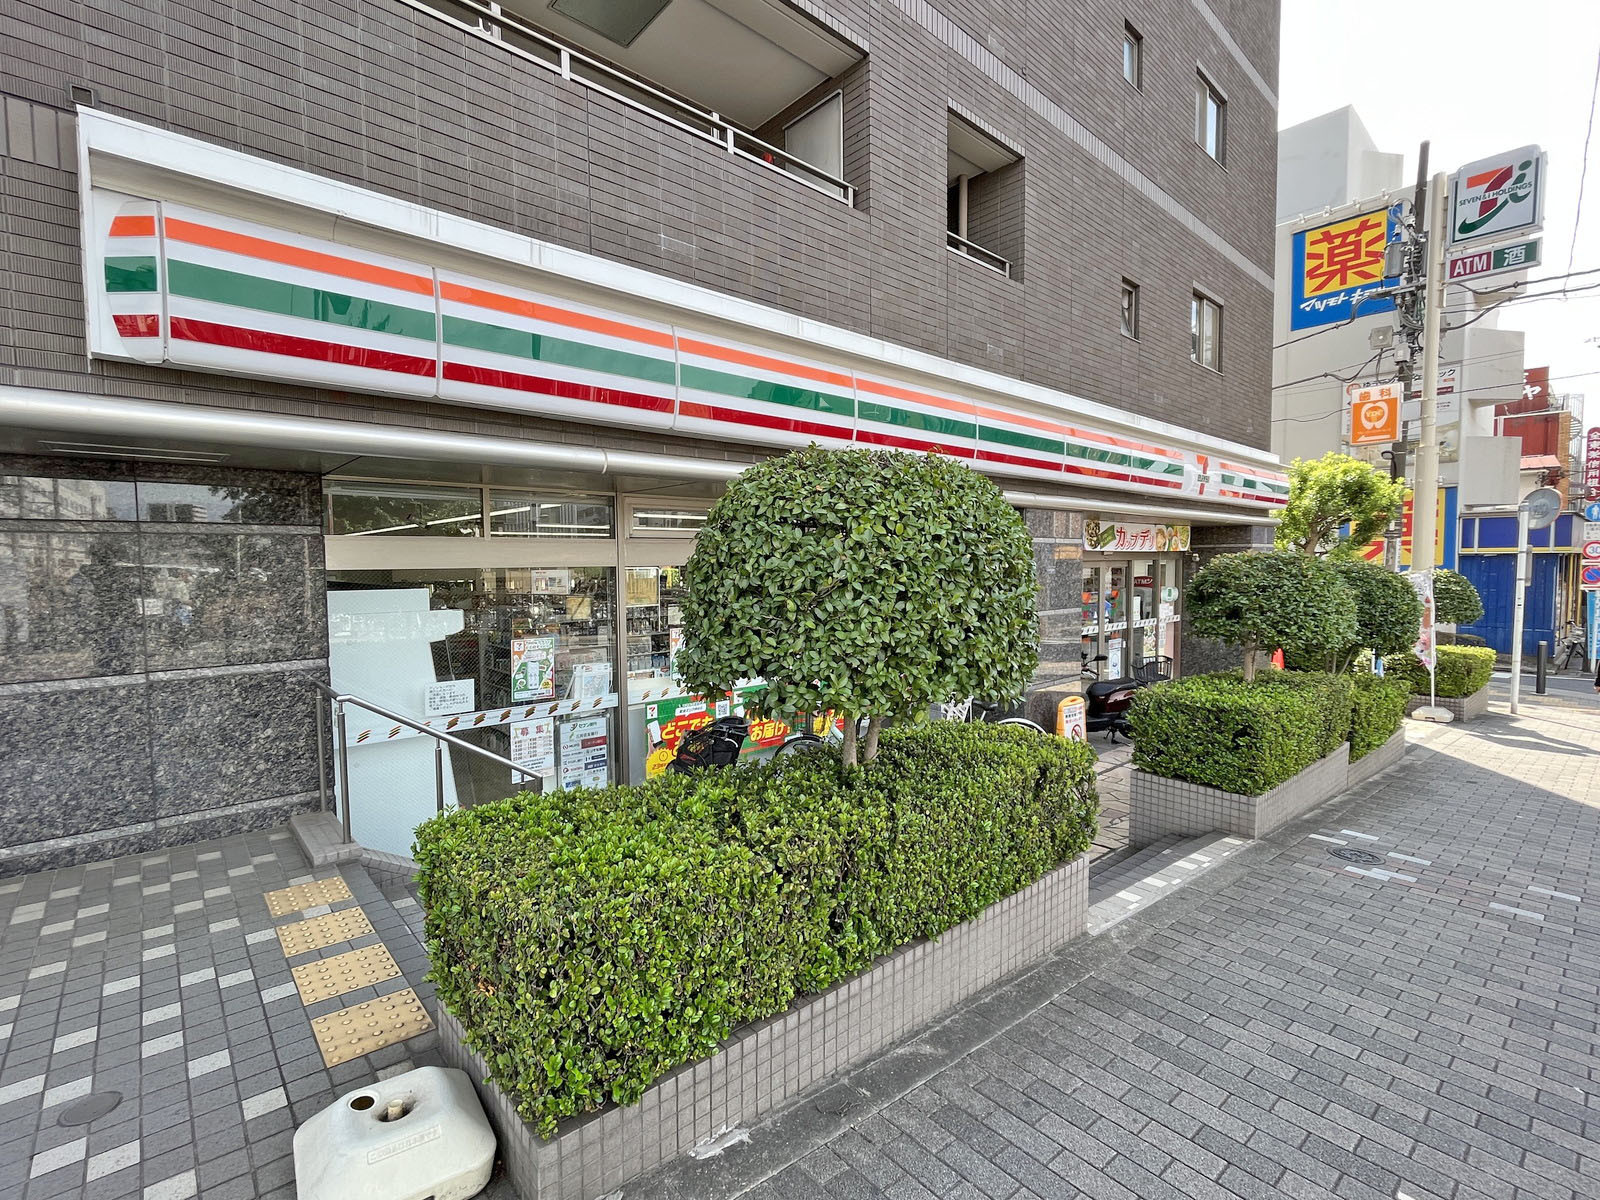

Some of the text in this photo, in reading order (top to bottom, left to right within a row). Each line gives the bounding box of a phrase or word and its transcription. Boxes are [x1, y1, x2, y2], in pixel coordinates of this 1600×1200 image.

[1459, 195, 1482, 207] SEVEN
[1492, 181, 1533, 198] HOLDINGS
[1306, 218, 1386, 293] 薬
[1453, 254, 1488, 277] ATM
[1503, 245, 1527, 267] 酒
